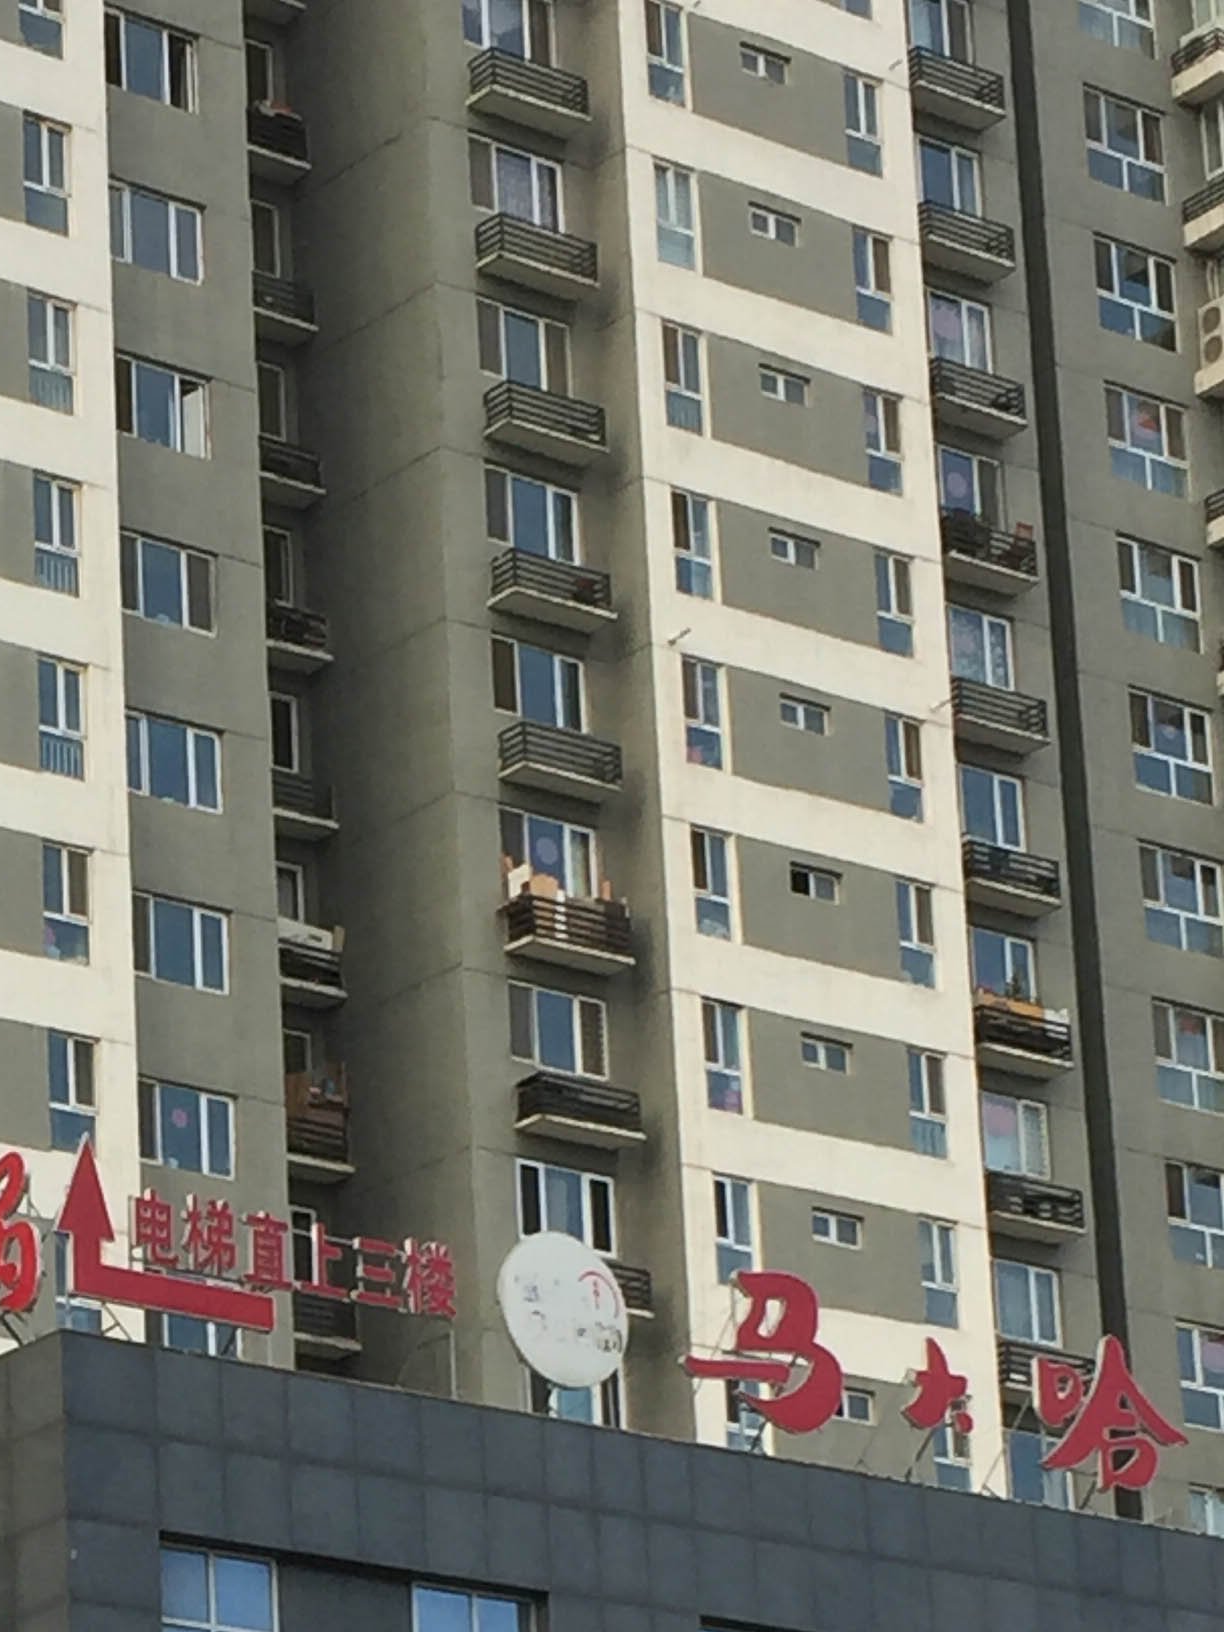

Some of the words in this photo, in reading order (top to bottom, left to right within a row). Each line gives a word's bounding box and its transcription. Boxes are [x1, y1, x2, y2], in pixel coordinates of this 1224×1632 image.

[133, 1187, 458, 1318] 电梯直上三楼
[684, 1268, 1189, 1493] 马大哈
